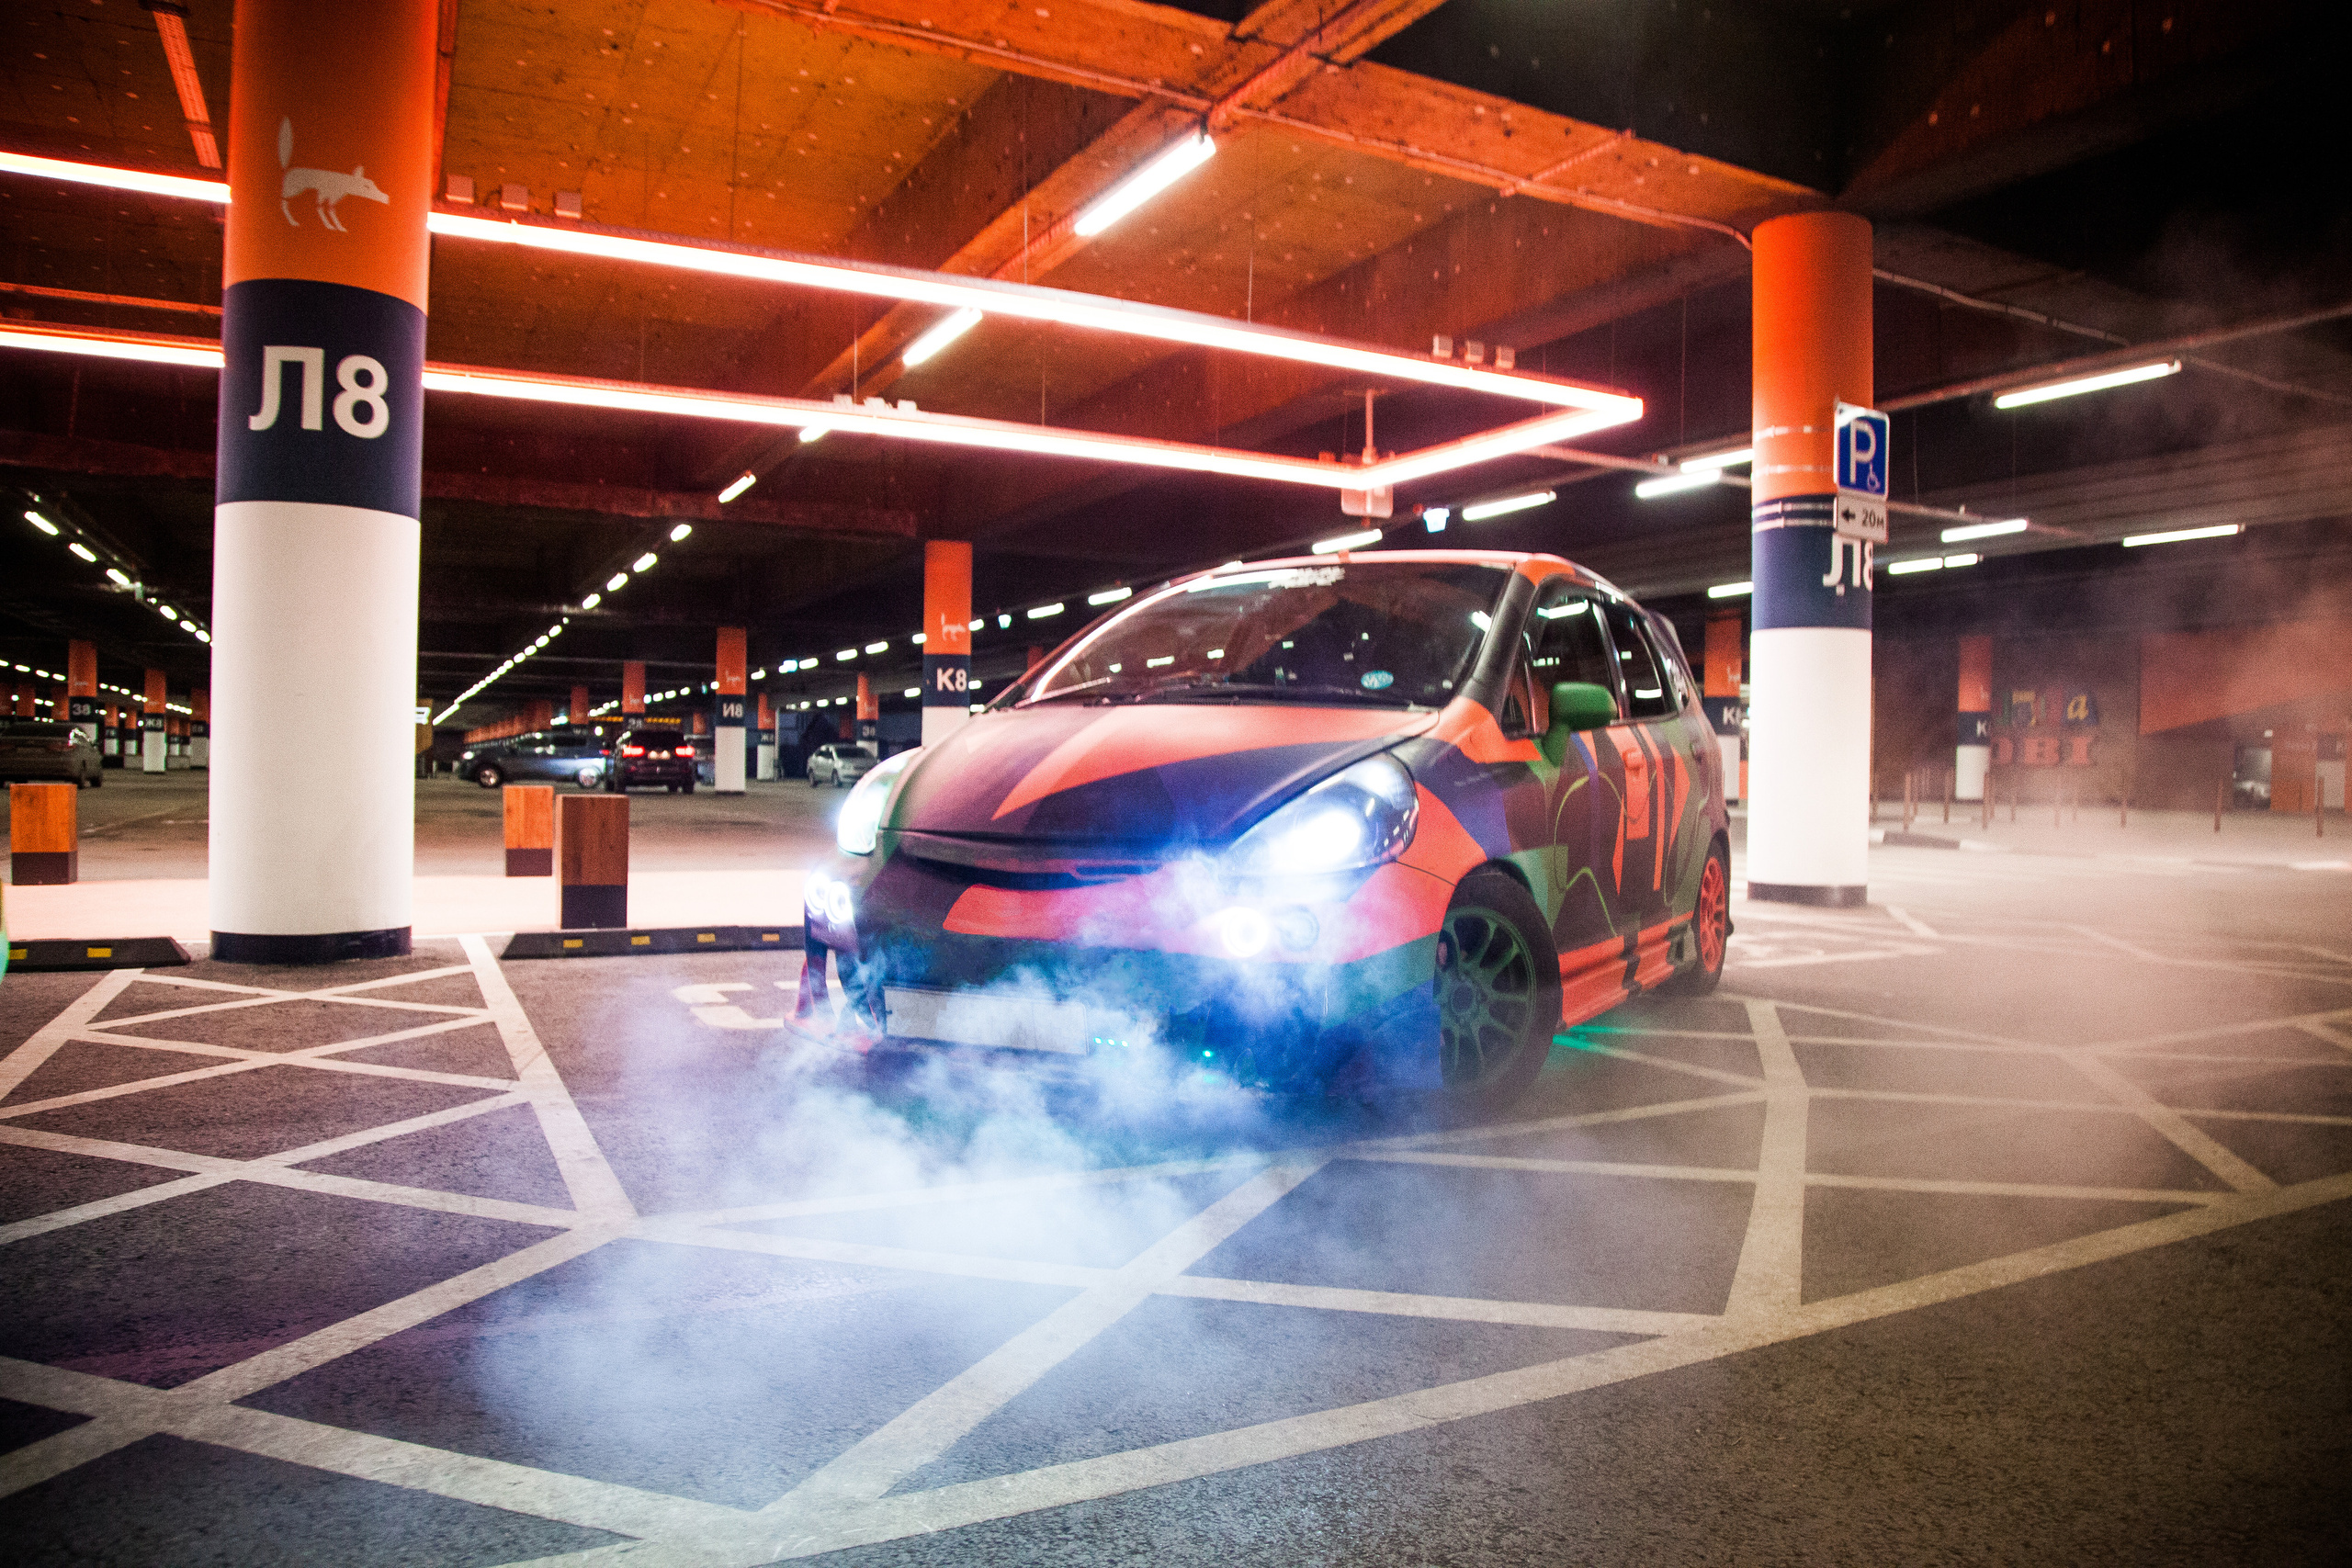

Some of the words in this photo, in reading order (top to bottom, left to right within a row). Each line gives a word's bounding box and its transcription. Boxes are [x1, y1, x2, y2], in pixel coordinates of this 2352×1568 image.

[248, 344, 390, 439] Л8
[937, 667, 967, 692] К8
[722, 703, 743, 718] И8
